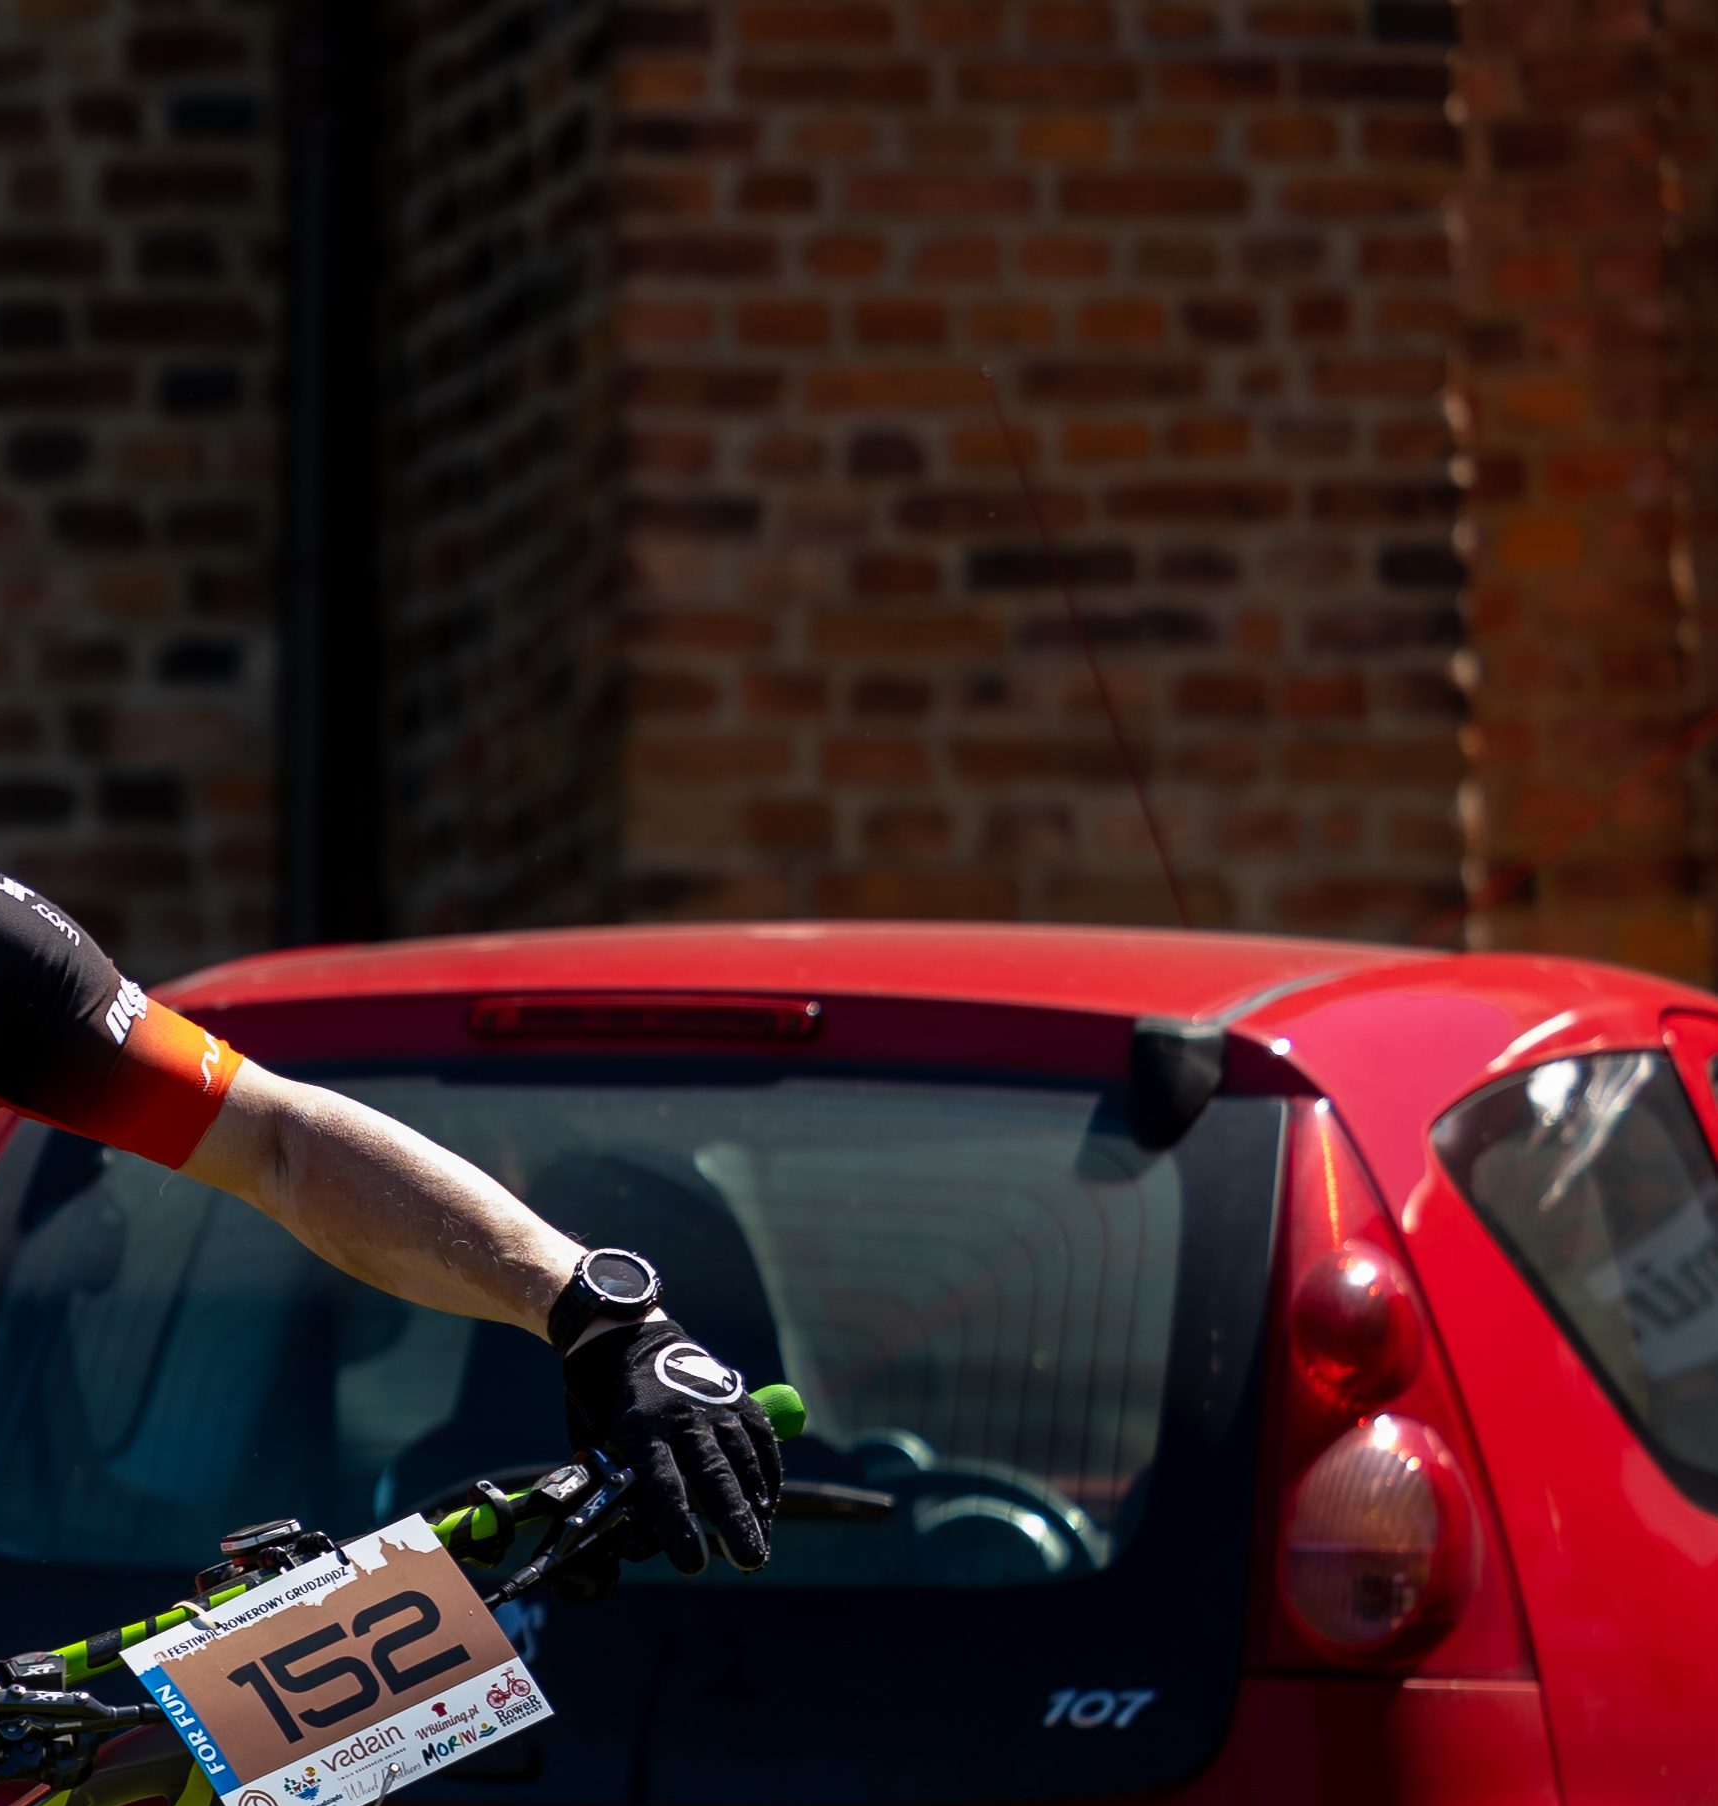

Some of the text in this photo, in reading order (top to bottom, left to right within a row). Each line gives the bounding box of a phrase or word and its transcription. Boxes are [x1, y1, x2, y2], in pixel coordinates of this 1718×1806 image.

[220, 1594, 286, 1633] ROWEROWY
[226, 1589, 472, 1745] 152
[154, 1684, 226, 1775] FOR FUN
[1039, 1687, 1158, 1731] 107
[320, 1725, 407, 1773] vadain
